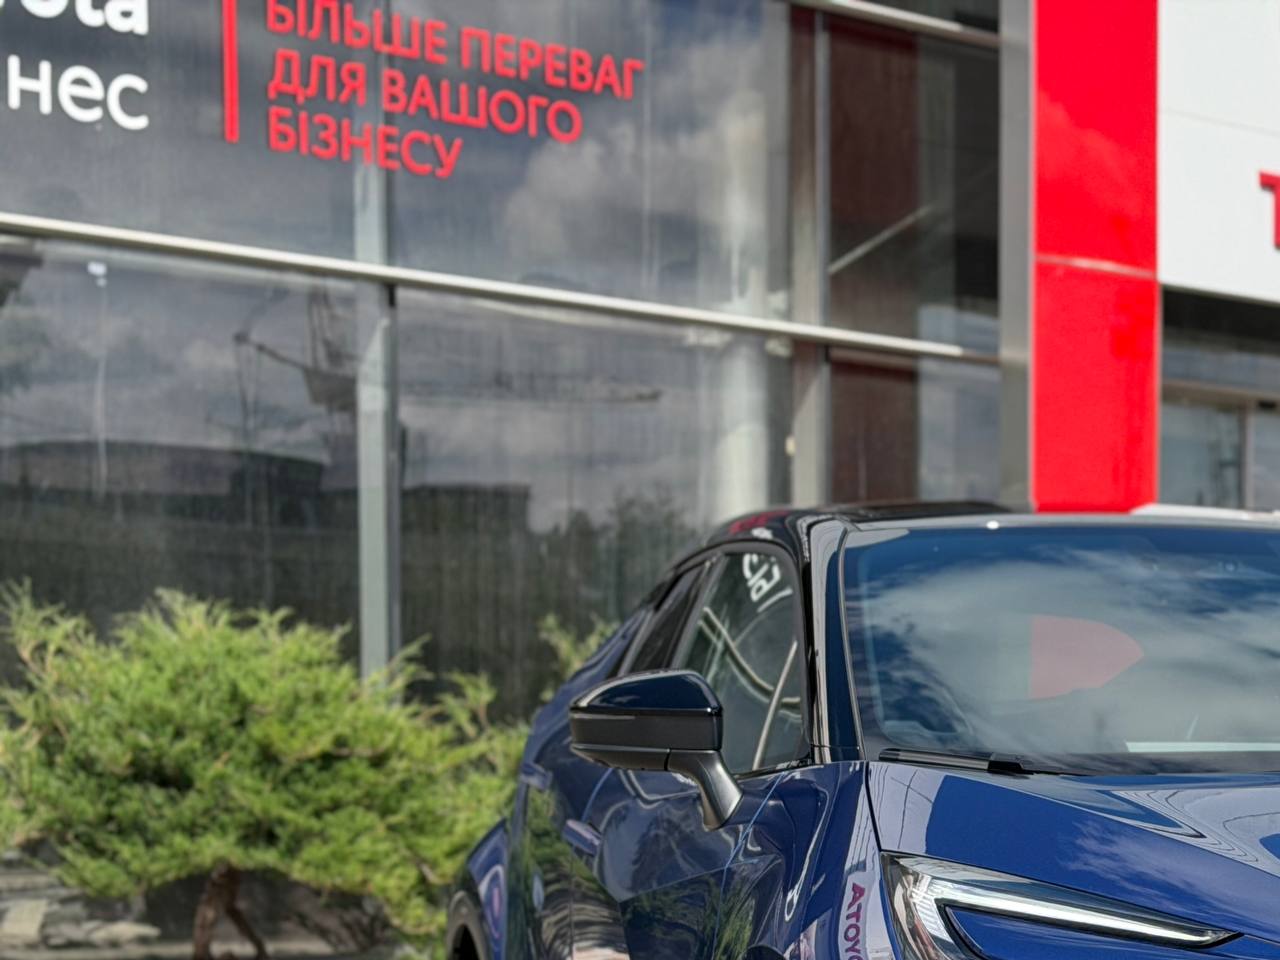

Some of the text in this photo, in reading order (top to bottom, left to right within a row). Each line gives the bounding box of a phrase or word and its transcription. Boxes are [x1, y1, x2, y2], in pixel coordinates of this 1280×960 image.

[268, 48, 583, 143] ДЛЯ ВАШОГО
[460, 26, 645, 99] ПЕРЕВАГ
[268, 105, 463, 179] БІЗНЕСУ
